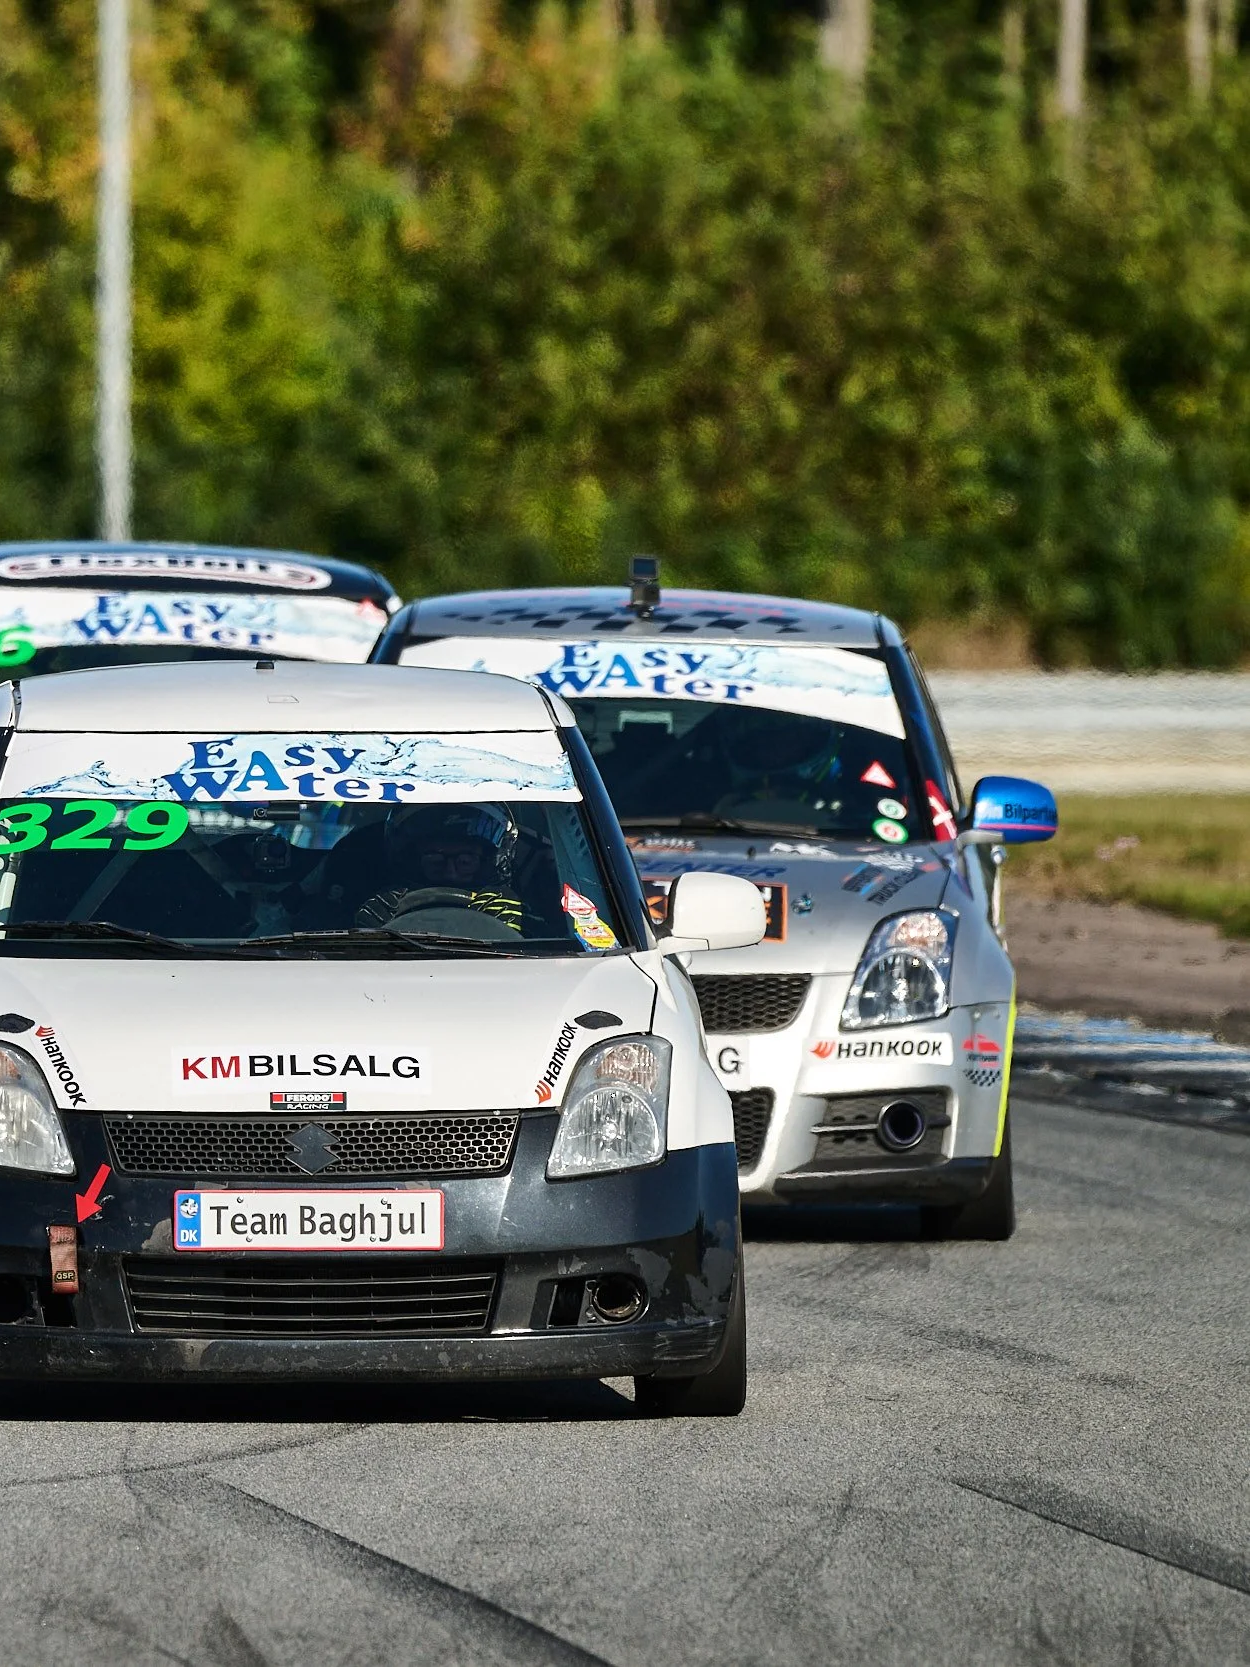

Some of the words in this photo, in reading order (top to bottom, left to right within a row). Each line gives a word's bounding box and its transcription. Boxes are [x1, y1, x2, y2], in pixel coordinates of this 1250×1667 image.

[286, 1094, 330, 1102] FERODO
[210, 1205, 288, 1237] Team
[300, 1201, 427, 1242] Baghjul
[180, 1229, 197, 1243] DK
